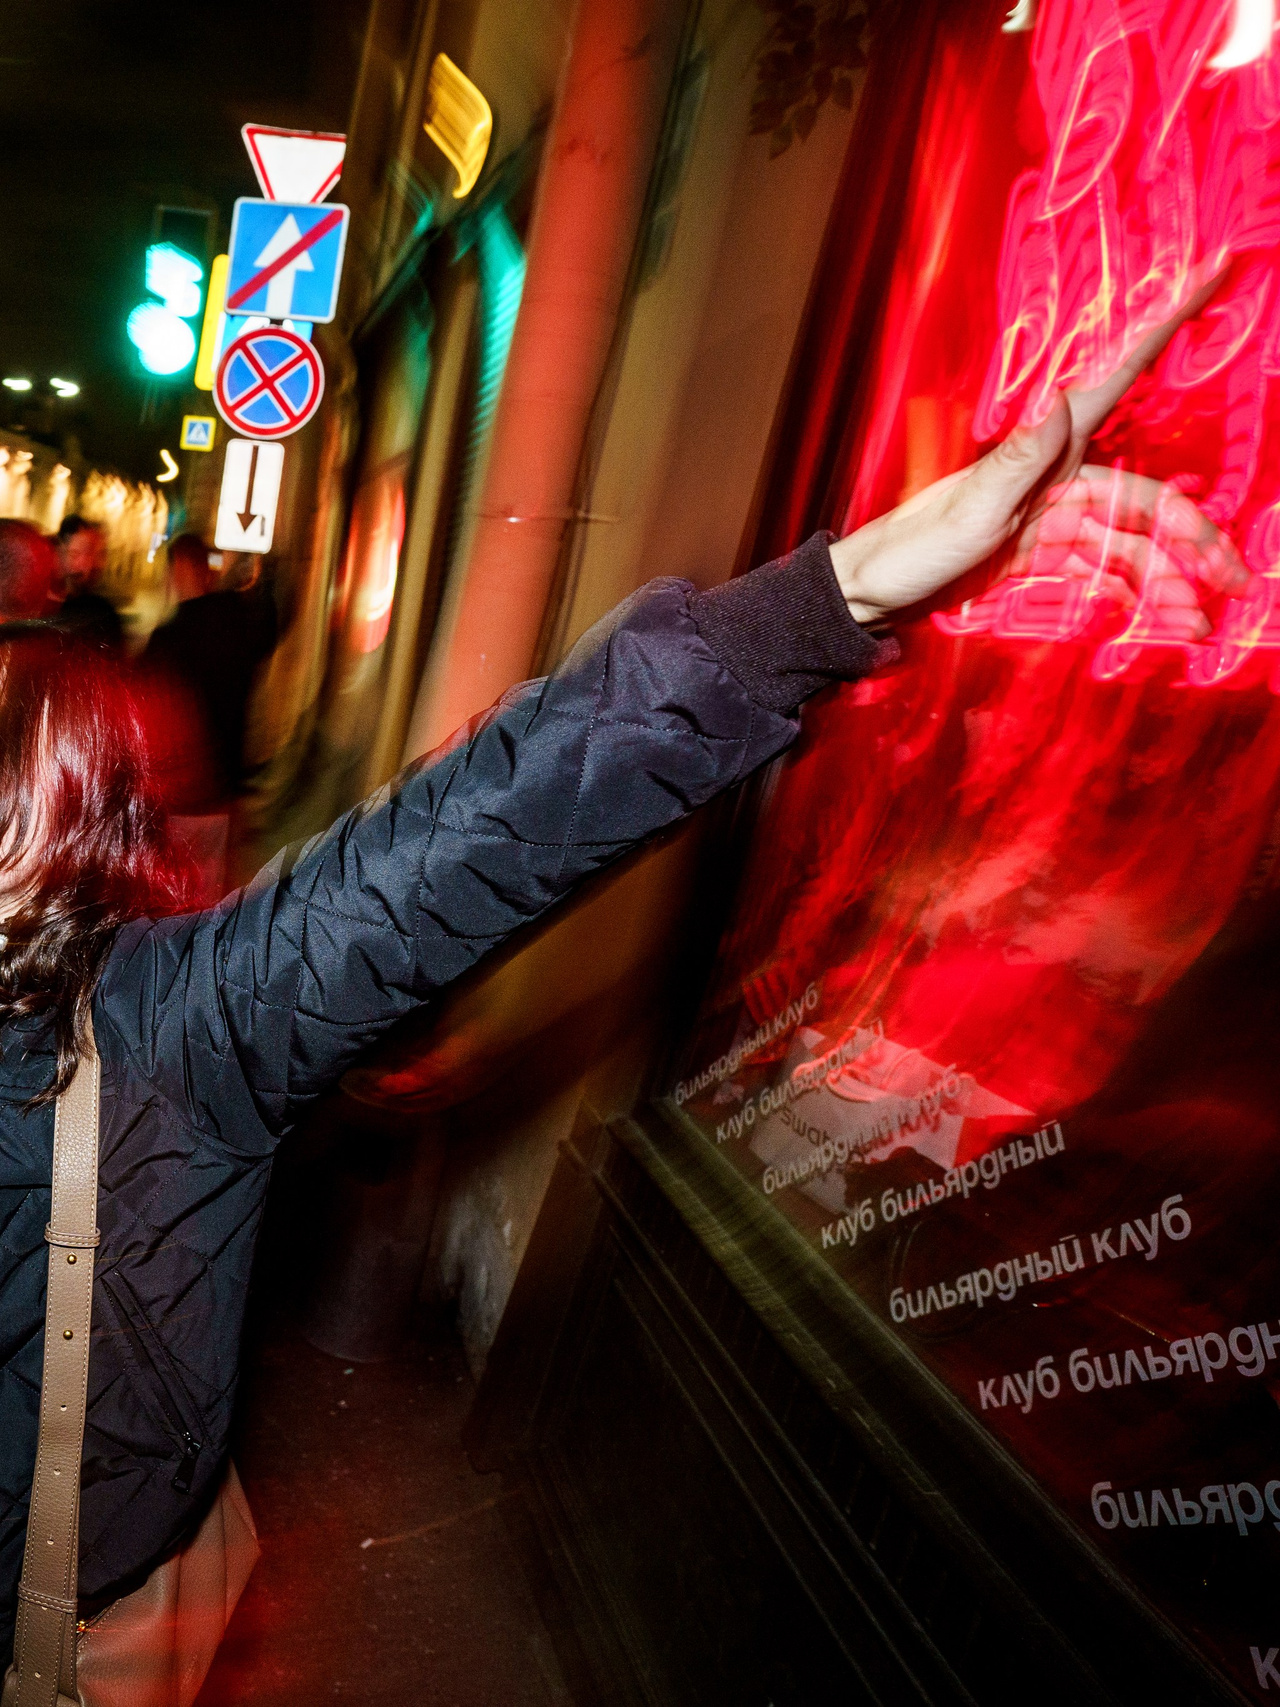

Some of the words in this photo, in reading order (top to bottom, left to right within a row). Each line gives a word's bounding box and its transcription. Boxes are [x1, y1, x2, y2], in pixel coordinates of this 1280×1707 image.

[774, 982, 819, 1037] клуб
[716, 1099, 756, 1144] клуб
[895, 1063, 962, 1133] клуб
[821, 1198, 876, 1249] клуб
[881, 1120, 1066, 1224] бильярдный
[889, 1235, 1086, 1323] бильярдный
[1093, 1195, 1193, 1265] клуб
[977, 1355, 1061, 1414] клуб
